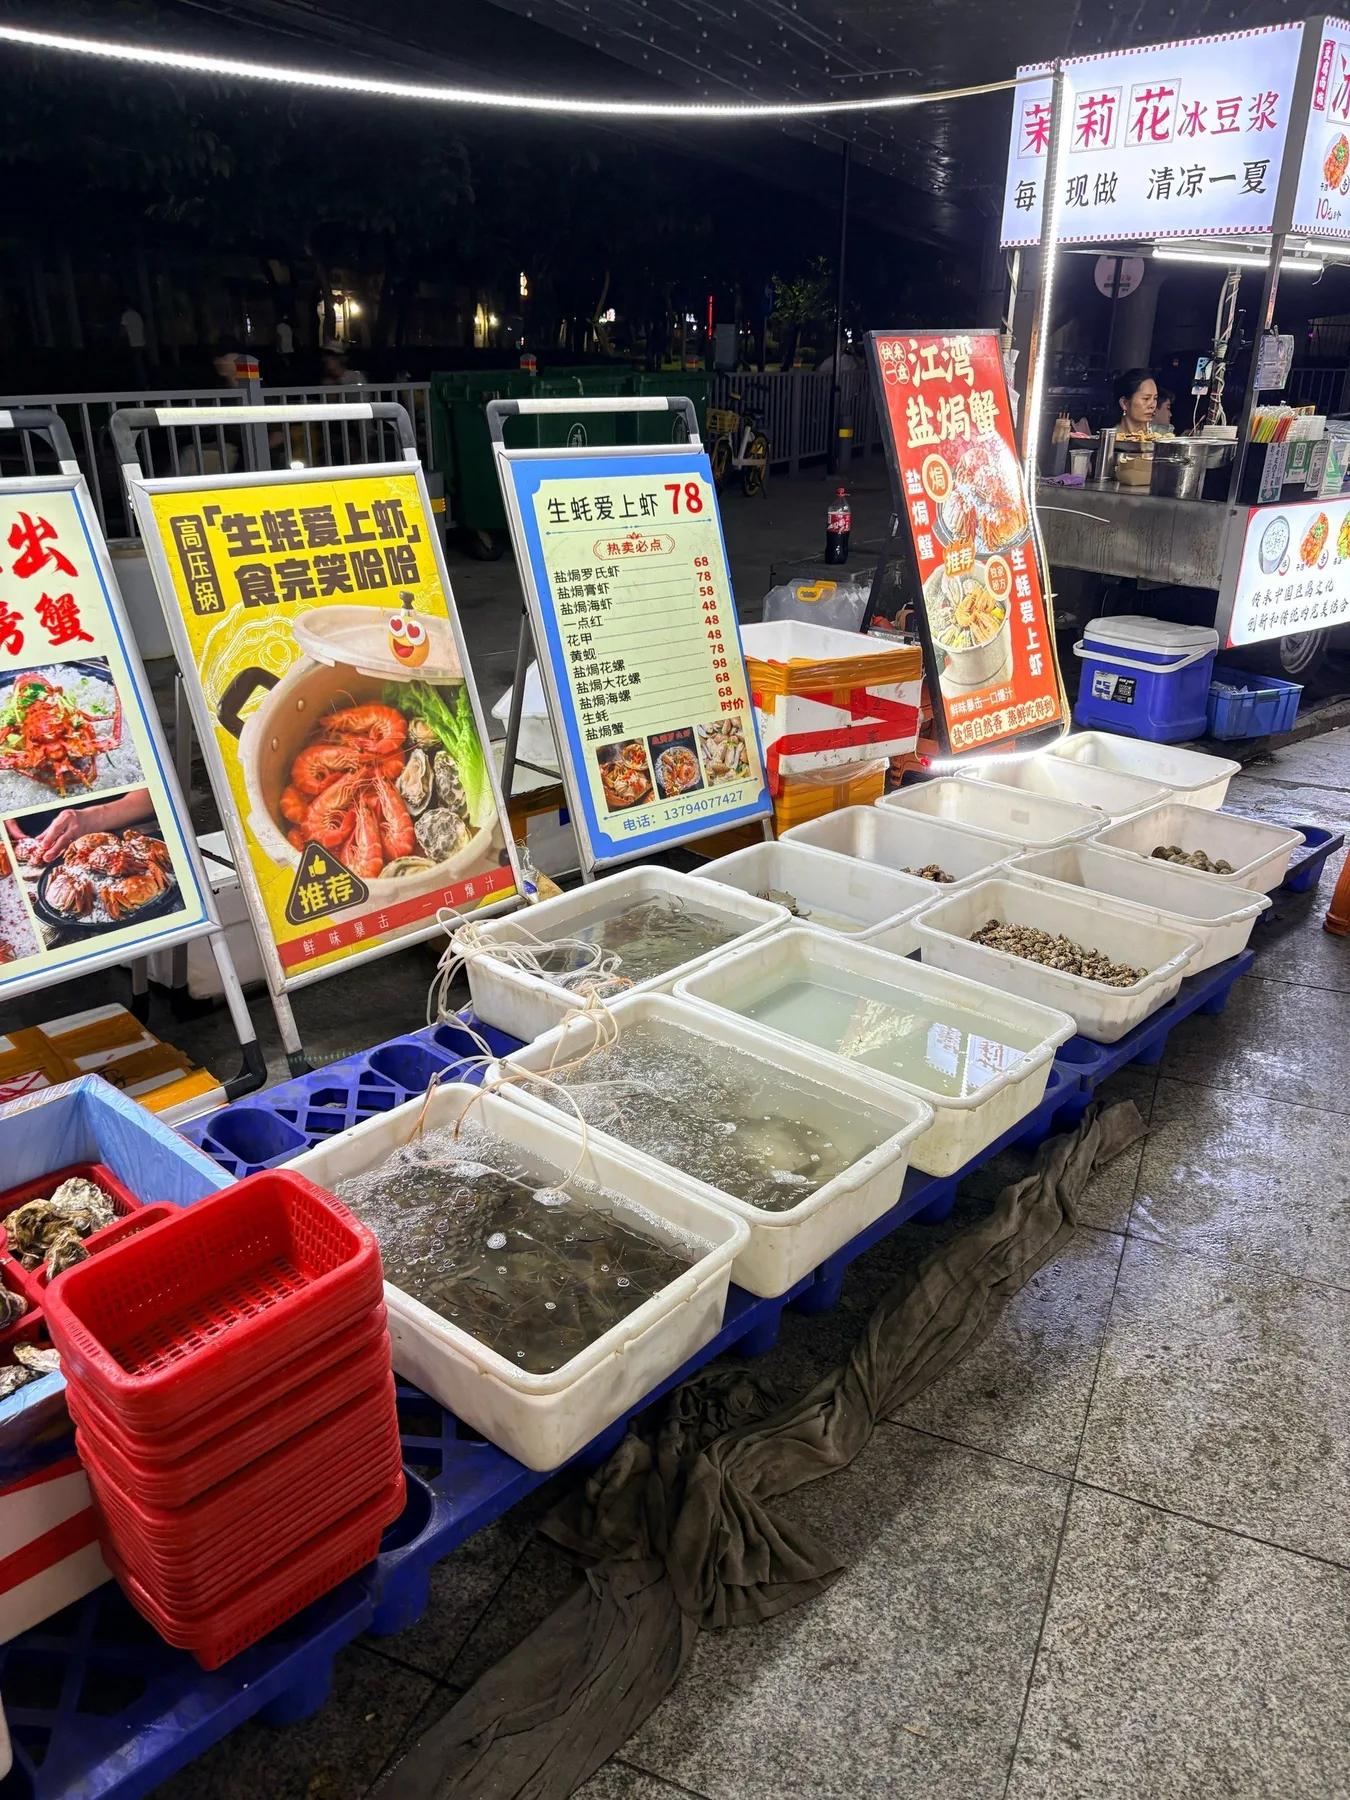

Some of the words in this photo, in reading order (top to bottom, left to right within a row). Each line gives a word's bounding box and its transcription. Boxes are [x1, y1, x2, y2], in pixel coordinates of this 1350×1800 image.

[1013, 171, 1119, 212] 每现做
[1146, 158, 1271, 201] 清凉一夏
[907, 335, 975, 388] 江湾
[905, 388, 1001, 449] 盐焗蟹
[547, 493, 660, 524] 生蚝爱上虾
[664, 482, 704, 514] 78
[904, 468, 935, 561] 盐焗蟹
[0, 511, 79, 579] 出
[202, 498, 422, 558] 「生蚝爱上虾」
[606, 538, 663, 556] 热卖必点
[176, 518, 220, 612] 高压锅
[234, 543, 421, 609] 食完笑哈哈
[554, 565, 620, 584] 盐焗罗氏虾
[693, 557, 709, 568] 68
[945, 550, 975, 577] 推荐
[556, 582, 611, 600] 盐焗膏虾
[696, 571, 712, 582] 78
[560, 597, 613, 616] 盐焗海虾
[699, 586, 714, 597] 58
[563, 615, 604, 630] 一点红
[702, 600, 717, 611] 48
[566, 632, 593, 648] 花甲
[704, 615, 720, 626] 48
[1010, 547, 1044, 677] 生蚝爱上虾
[569, 647, 597, 664] 黄蚬
[707, 629, 723, 640] 48
[572, 659, 626, 679] 盐焗花螺
[710, 643, 725, 654] 78
[576, 672, 642, 695] 盐焗大花螺
[712, 658, 728, 669] 98
[579, 689, 632, 711] 盐焗海螺
[715, 672, 730, 683] 68
[582, 709, 610, 726] 生蚝
[718, 686, 733, 697] 68
[585, 721, 625, 742] 盐焗蟹
[720, 697, 745, 712] 时价
[949, 687, 1014, 717] 鲜味暴击一口爆汁
[952, 714, 1003, 745] 盐焗自然香
[1006, 698, 1054, 727] 蒸鲜吃得到
[663, 790, 743, 821] 13794077427
[298, 872, 354, 915] 推荐
[303, 913, 389, 956] 鲜味暴击
[422, 875, 495, 908] 一口爆汁
